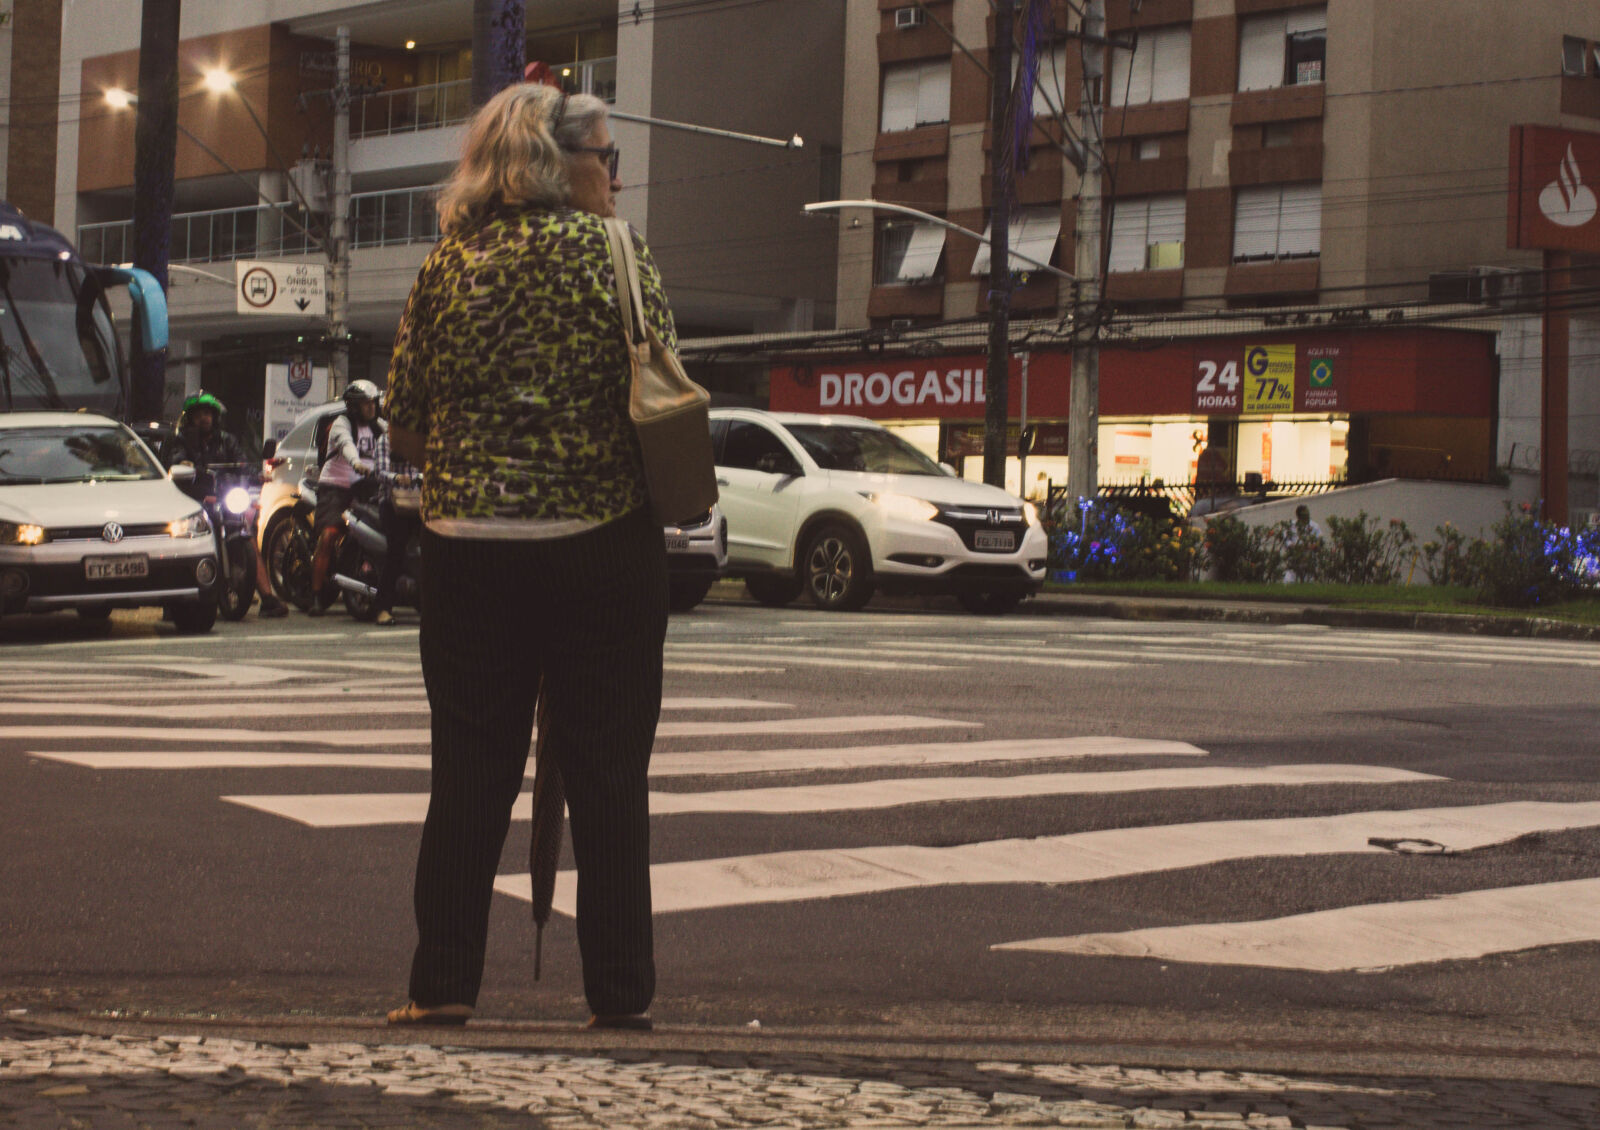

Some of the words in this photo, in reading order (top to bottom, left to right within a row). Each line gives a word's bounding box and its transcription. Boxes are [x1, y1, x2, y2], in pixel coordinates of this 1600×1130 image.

[820, 368, 986, 406] DROGASIL
[1197, 360, 1240, 392] 24
[1255, 377, 1292, 400] 77%
[1197, 395, 1238, 408] HORAS
